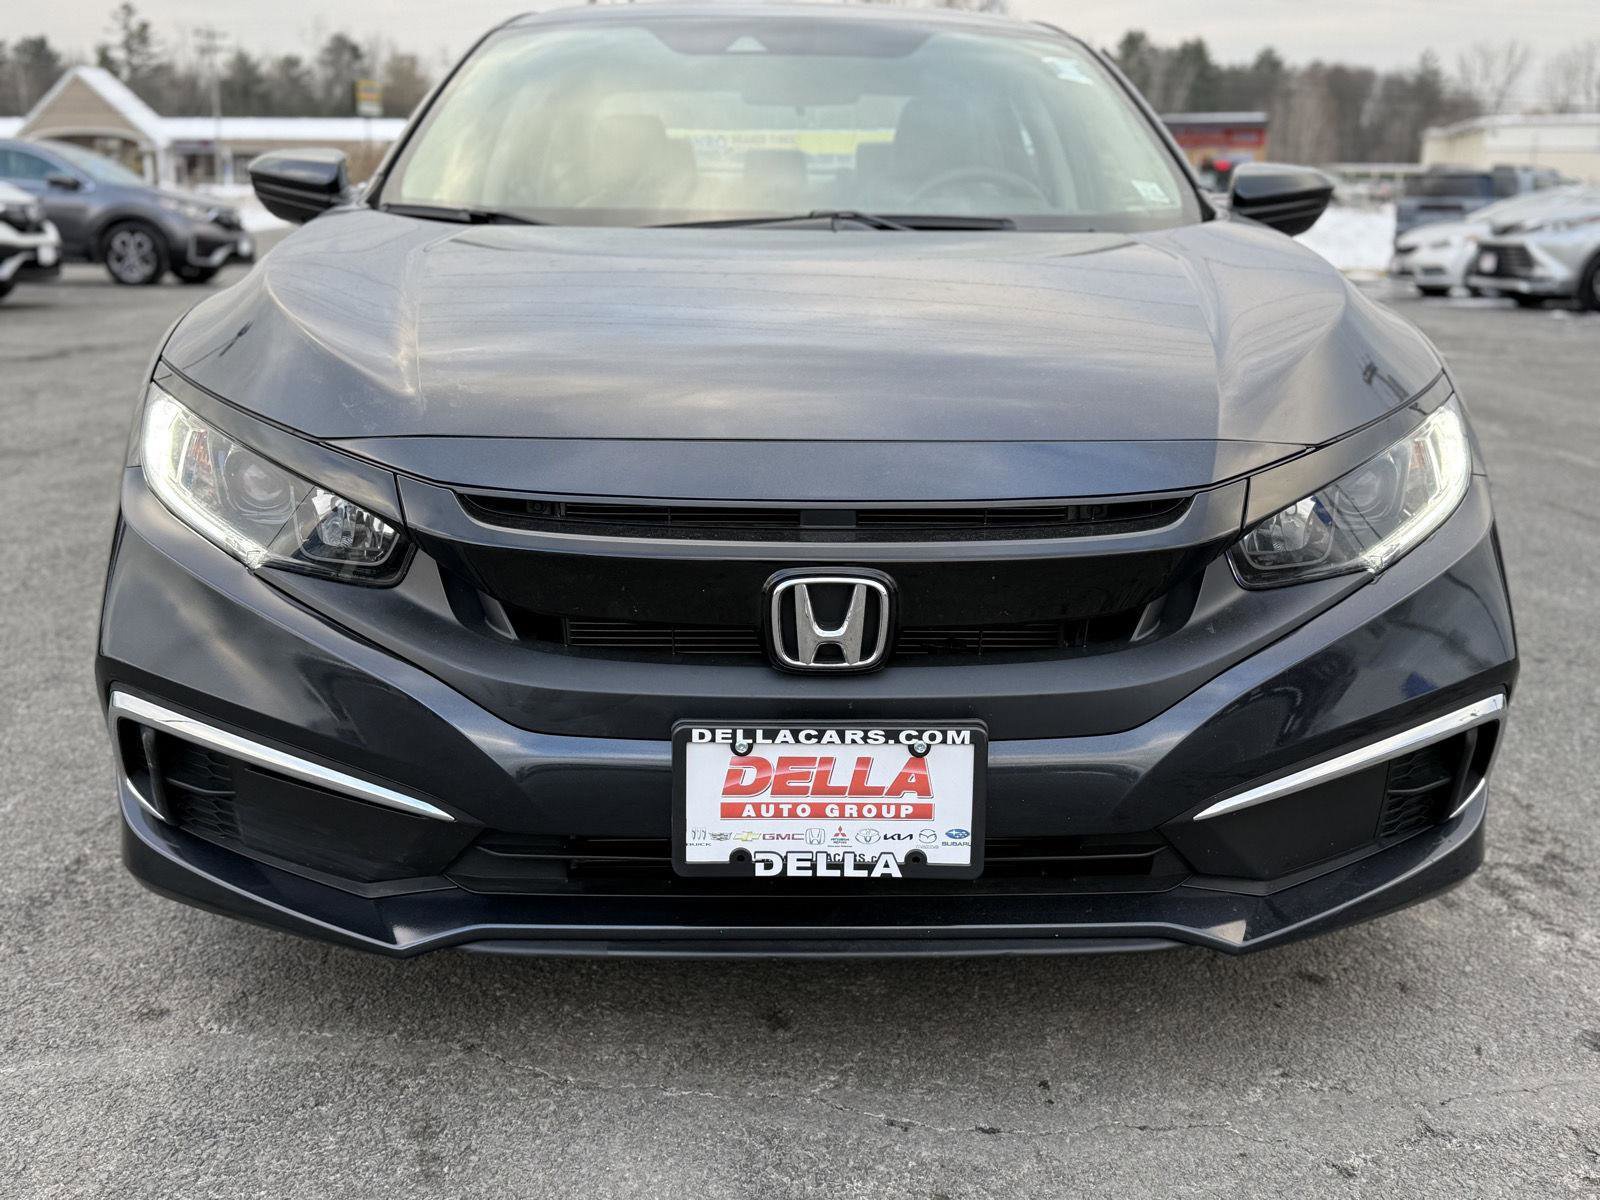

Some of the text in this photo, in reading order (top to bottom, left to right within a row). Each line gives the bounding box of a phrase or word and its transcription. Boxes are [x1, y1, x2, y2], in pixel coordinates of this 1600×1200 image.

[691, 728, 971, 745] DELLACARS.COM
[721, 755, 934, 798] DELLA
[741, 803, 914, 818] AUTO GROUP
[762, 833, 804, 841] GMC
[754, 851, 903, 877] DELLA
